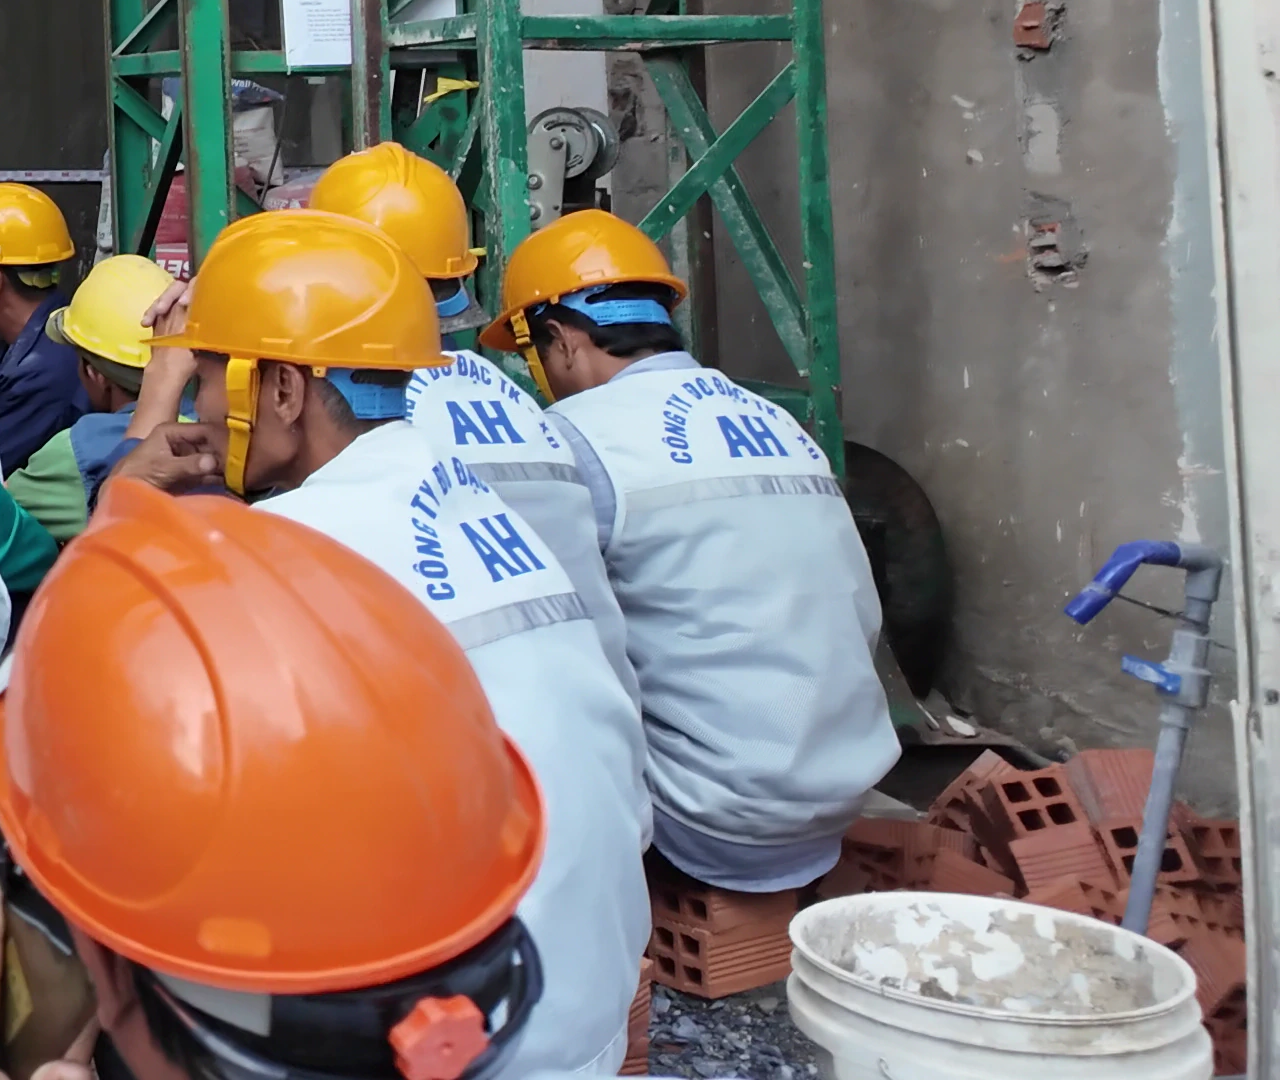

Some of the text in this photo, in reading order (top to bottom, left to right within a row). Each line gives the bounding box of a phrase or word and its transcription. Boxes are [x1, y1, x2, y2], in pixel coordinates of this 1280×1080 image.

[456, 354, 492, 385] ĐẠC
[445, 400, 527, 445] AH
[665, 393, 693, 414] TY
[662, 410, 693, 464] CÔNG
[716, 414, 789, 458] AH
[410, 479, 441, 520] TY
[411, 517, 456, 601] CÔNG
[459, 513, 547, 583] AH
